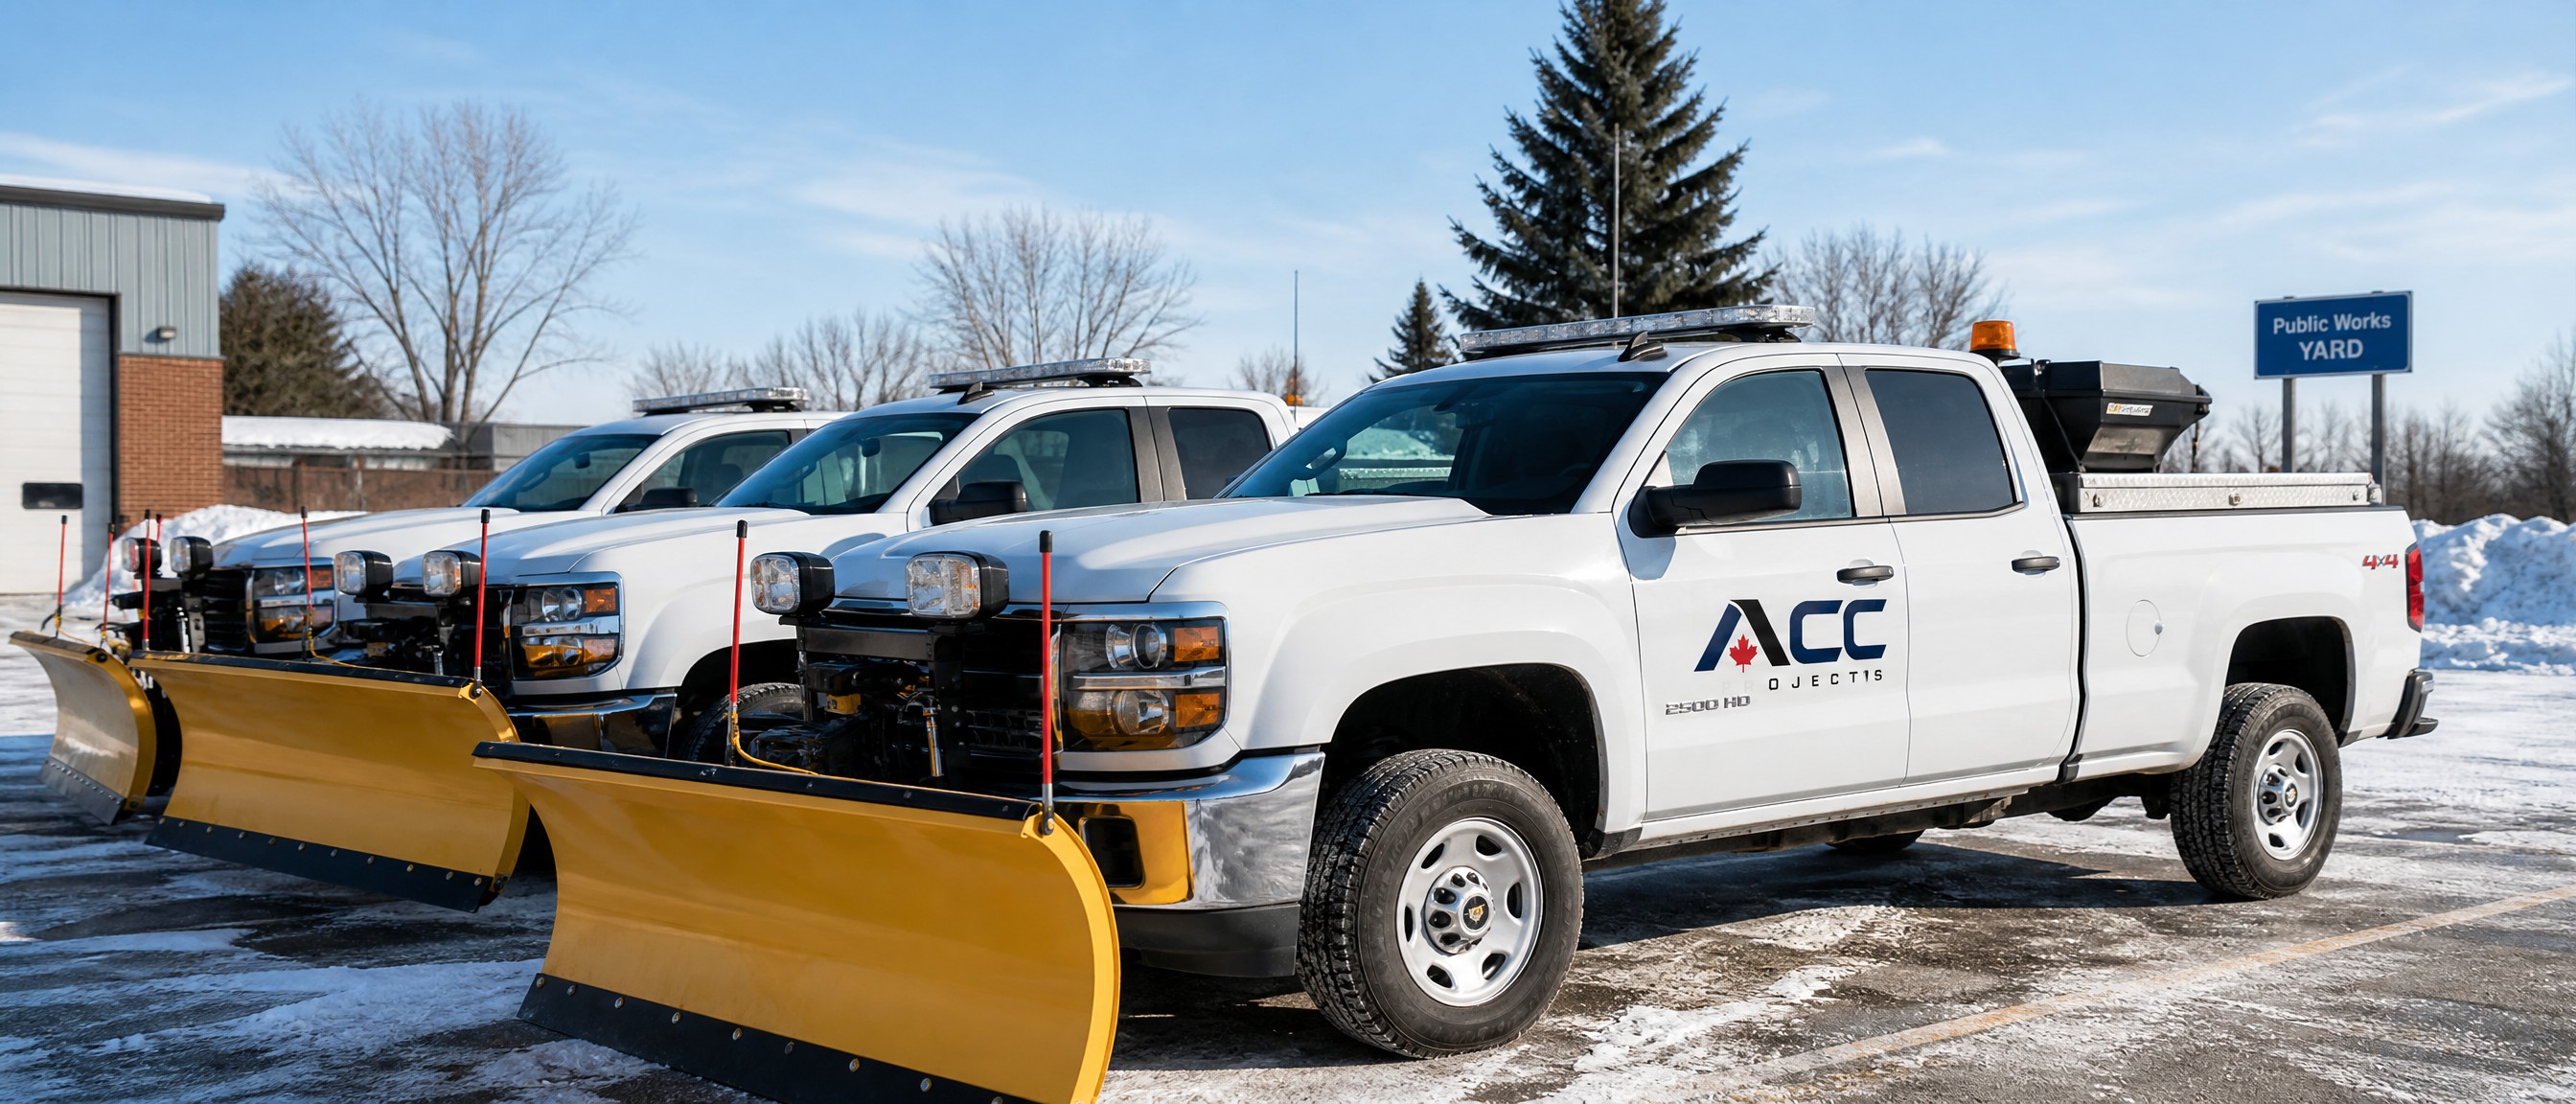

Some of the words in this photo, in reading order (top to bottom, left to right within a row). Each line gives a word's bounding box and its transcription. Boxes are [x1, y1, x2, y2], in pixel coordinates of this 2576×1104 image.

[2273, 315, 2329, 334] Public
[2334, 311, 2392, 331] Works
[2299, 338, 2364, 360] YARD
[1693, 599, 1887, 672] ACC
[1665, 698, 1719, 716] 2500
[1723, 695, 1751, 709] HD
